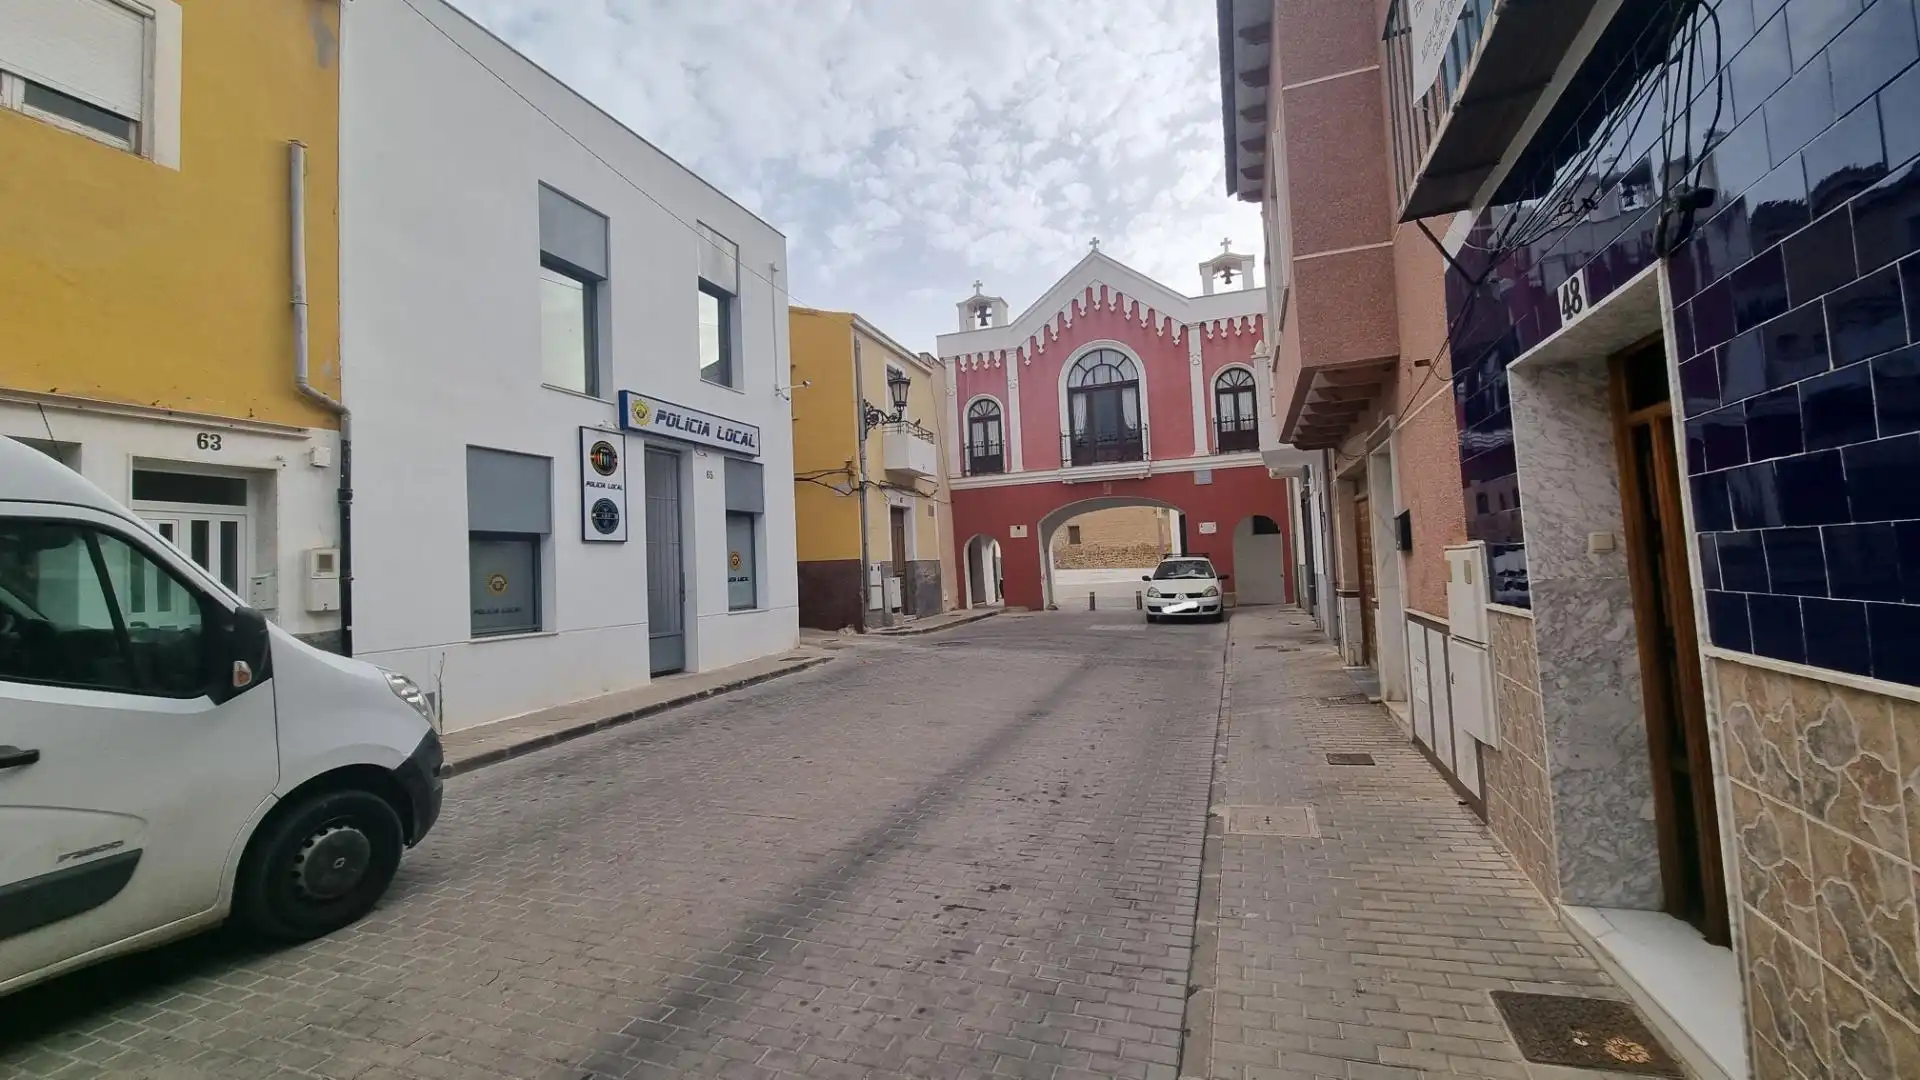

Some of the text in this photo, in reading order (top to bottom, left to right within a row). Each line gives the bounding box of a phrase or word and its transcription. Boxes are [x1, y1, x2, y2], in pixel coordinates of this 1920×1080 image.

[1562, 276, 1582, 320] 48
[655, 409, 755, 448] POLICIA LOCAL
[197, 432, 222, 451] 63
[706, 470, 714, 480] 65
[607, 483, 623, 491] LOCAL
